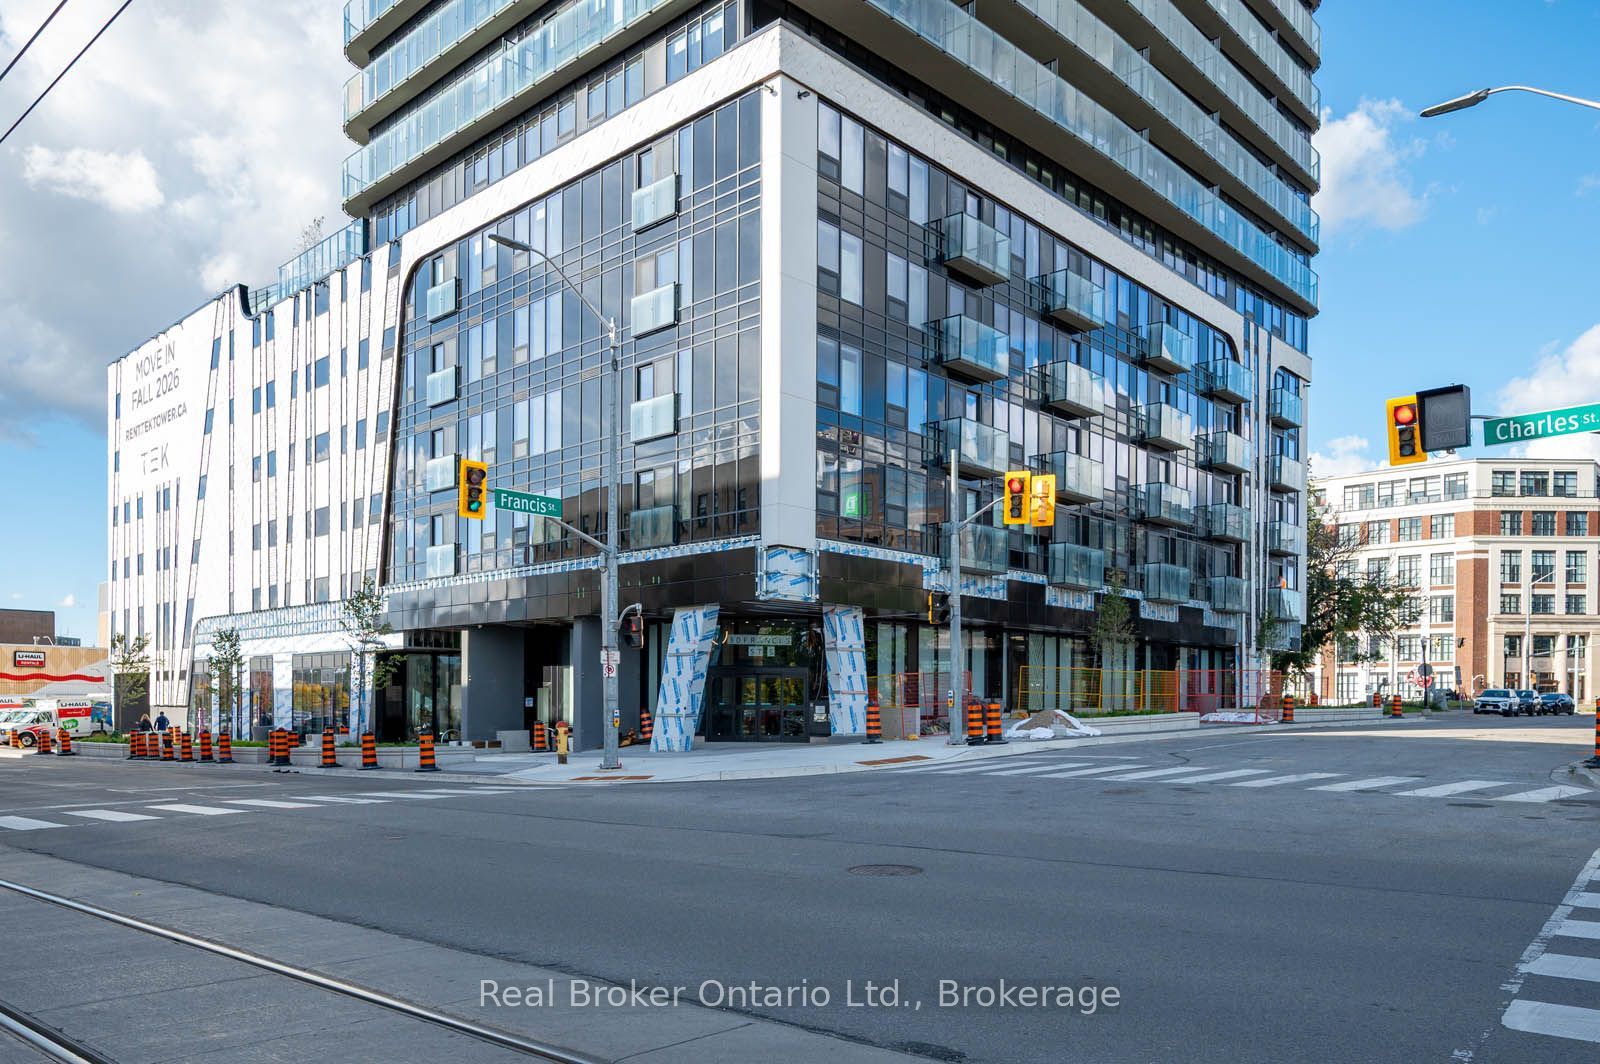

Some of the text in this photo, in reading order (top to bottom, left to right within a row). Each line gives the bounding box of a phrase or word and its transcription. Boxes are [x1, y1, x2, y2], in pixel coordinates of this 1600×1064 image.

[135, 340, 176, 381] MOVE IN
[131, 367, 180, 411] FALL 2026
[125, 402, 188, 441] RENTTEKTOWER.CA
[1496, 414, 1579, 440] Charles
[501, 493, 546, 513] Francis
